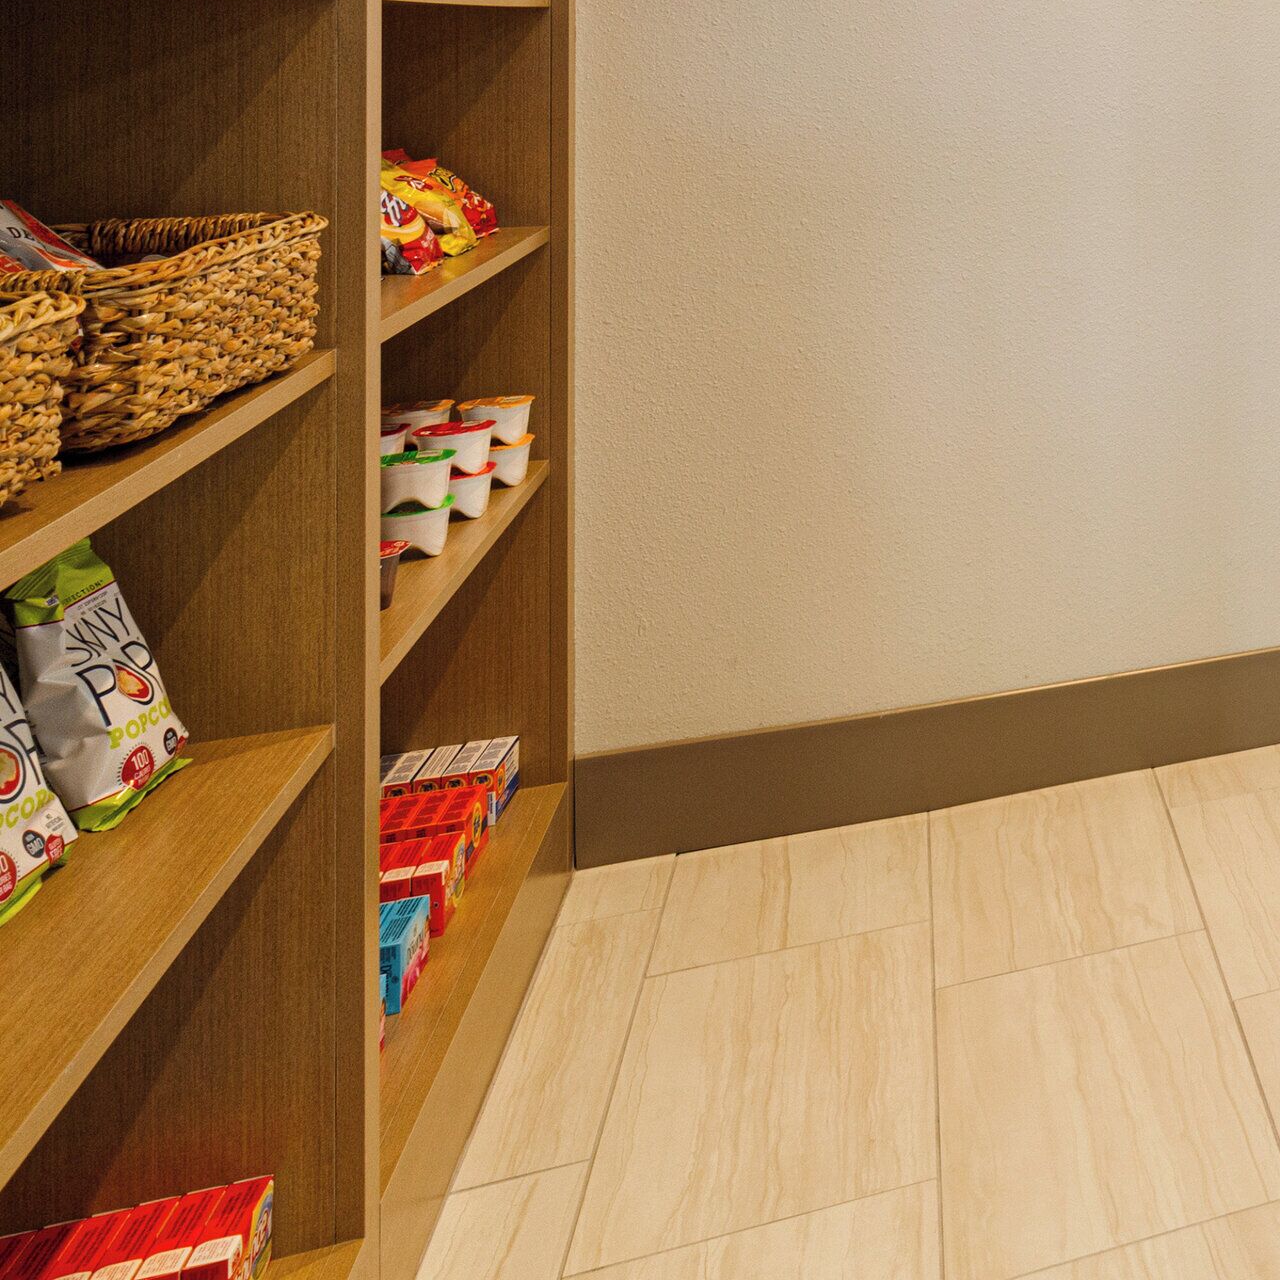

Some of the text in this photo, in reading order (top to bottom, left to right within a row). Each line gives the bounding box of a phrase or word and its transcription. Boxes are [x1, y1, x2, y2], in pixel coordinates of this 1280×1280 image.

[75, 640, 164, 727] POP
[107, 697, 173, 751] POPCO
[131, 749, 150, 771] 100
[26, 837, 45, 857] GMO
